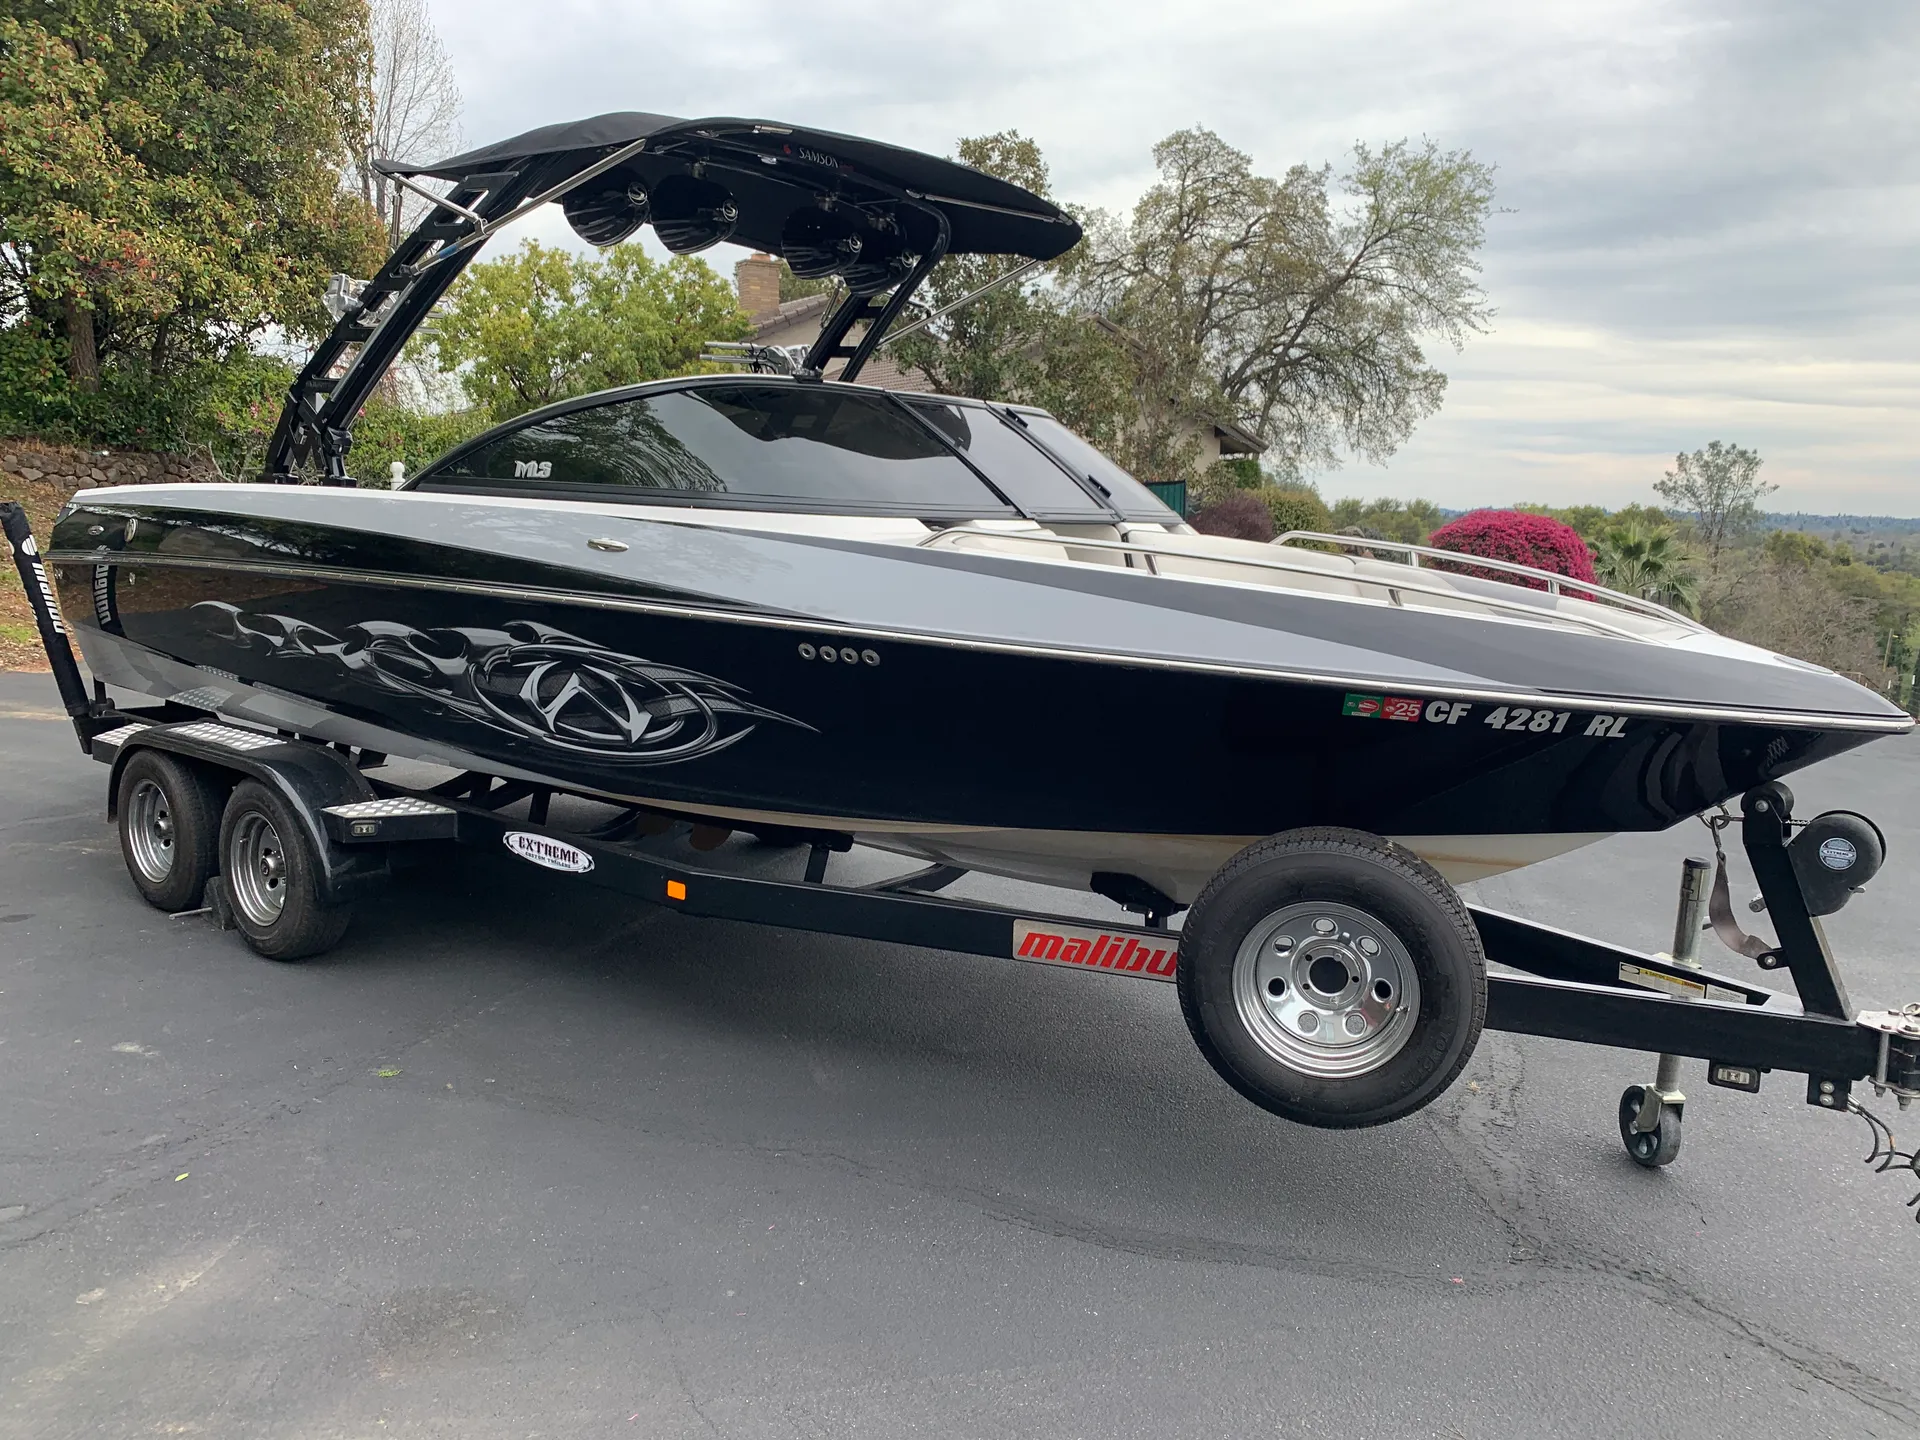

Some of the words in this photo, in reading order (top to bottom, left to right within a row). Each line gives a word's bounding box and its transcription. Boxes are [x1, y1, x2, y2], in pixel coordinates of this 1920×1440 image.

[799, 147, 839, 169] SAMSON
[1394, 702, 1421, 717] 25
[1425, 700, 1472, 725] CF
[1484, 706, 1571, 734] 4281
[1583, 715, 1629, 738] RL
[1017, 932, 1178, 977] malibu
